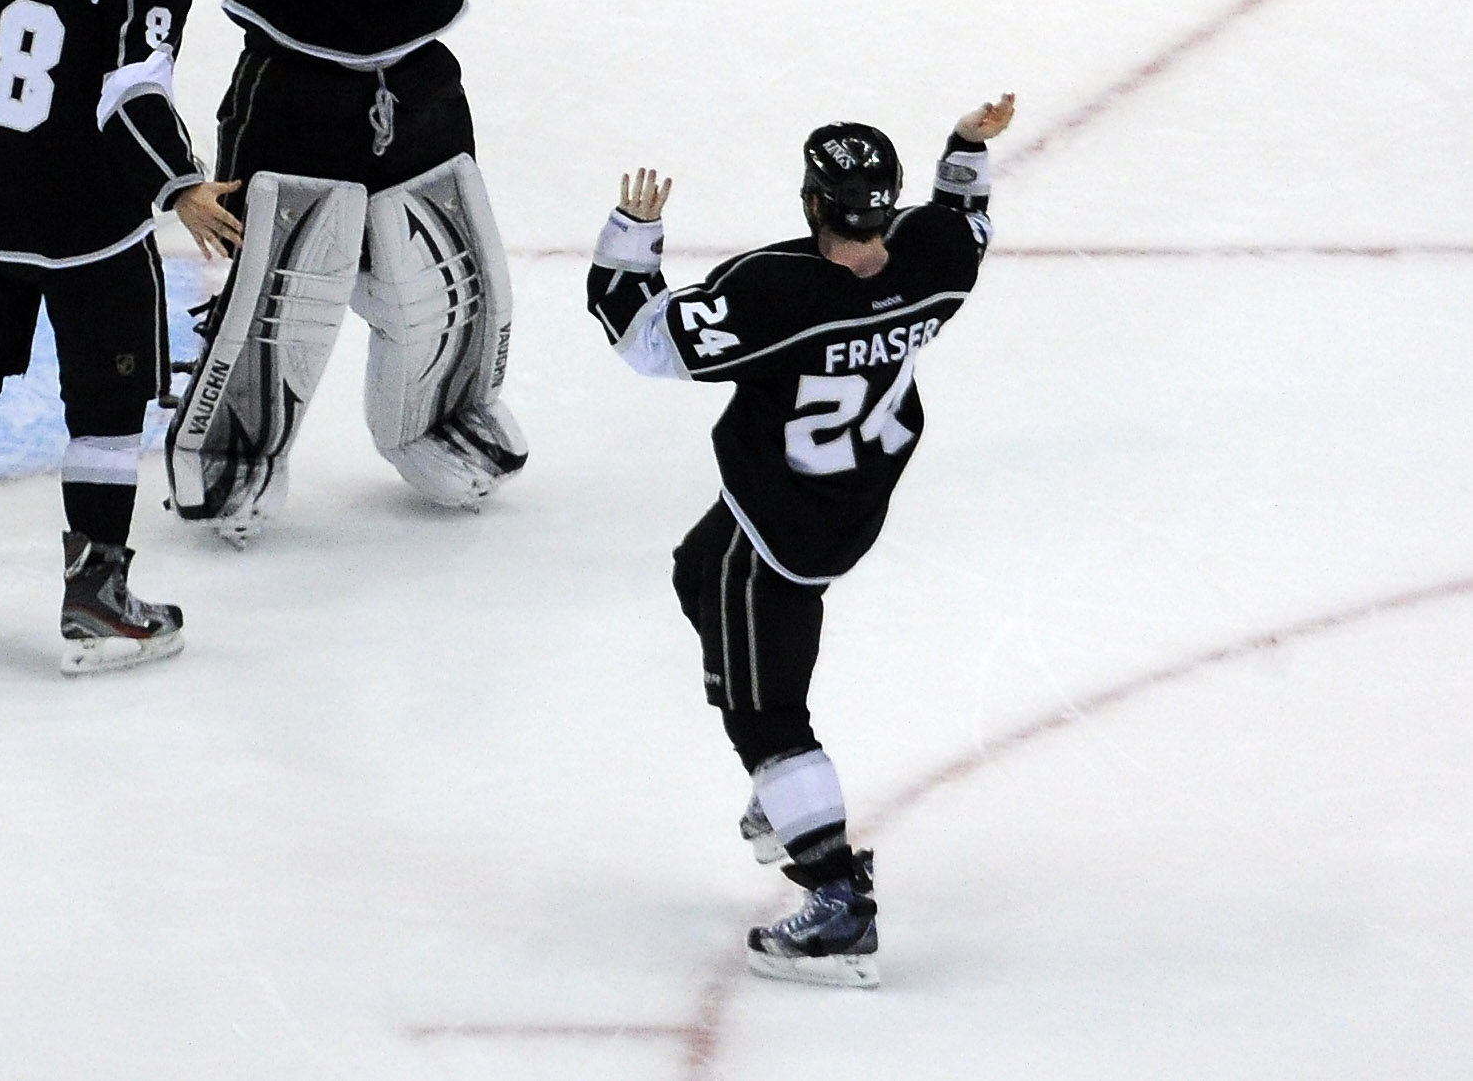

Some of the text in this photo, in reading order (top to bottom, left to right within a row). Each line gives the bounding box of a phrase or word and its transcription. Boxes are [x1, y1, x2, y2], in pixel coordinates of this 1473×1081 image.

[145, 6, 173, 50] 8
[870, 189, 891, 208] 24
[679, 295, 741, 359] 24
[825, 317, 940, 374] FRASER
[188, 360, 231, 437] VAUGHN
